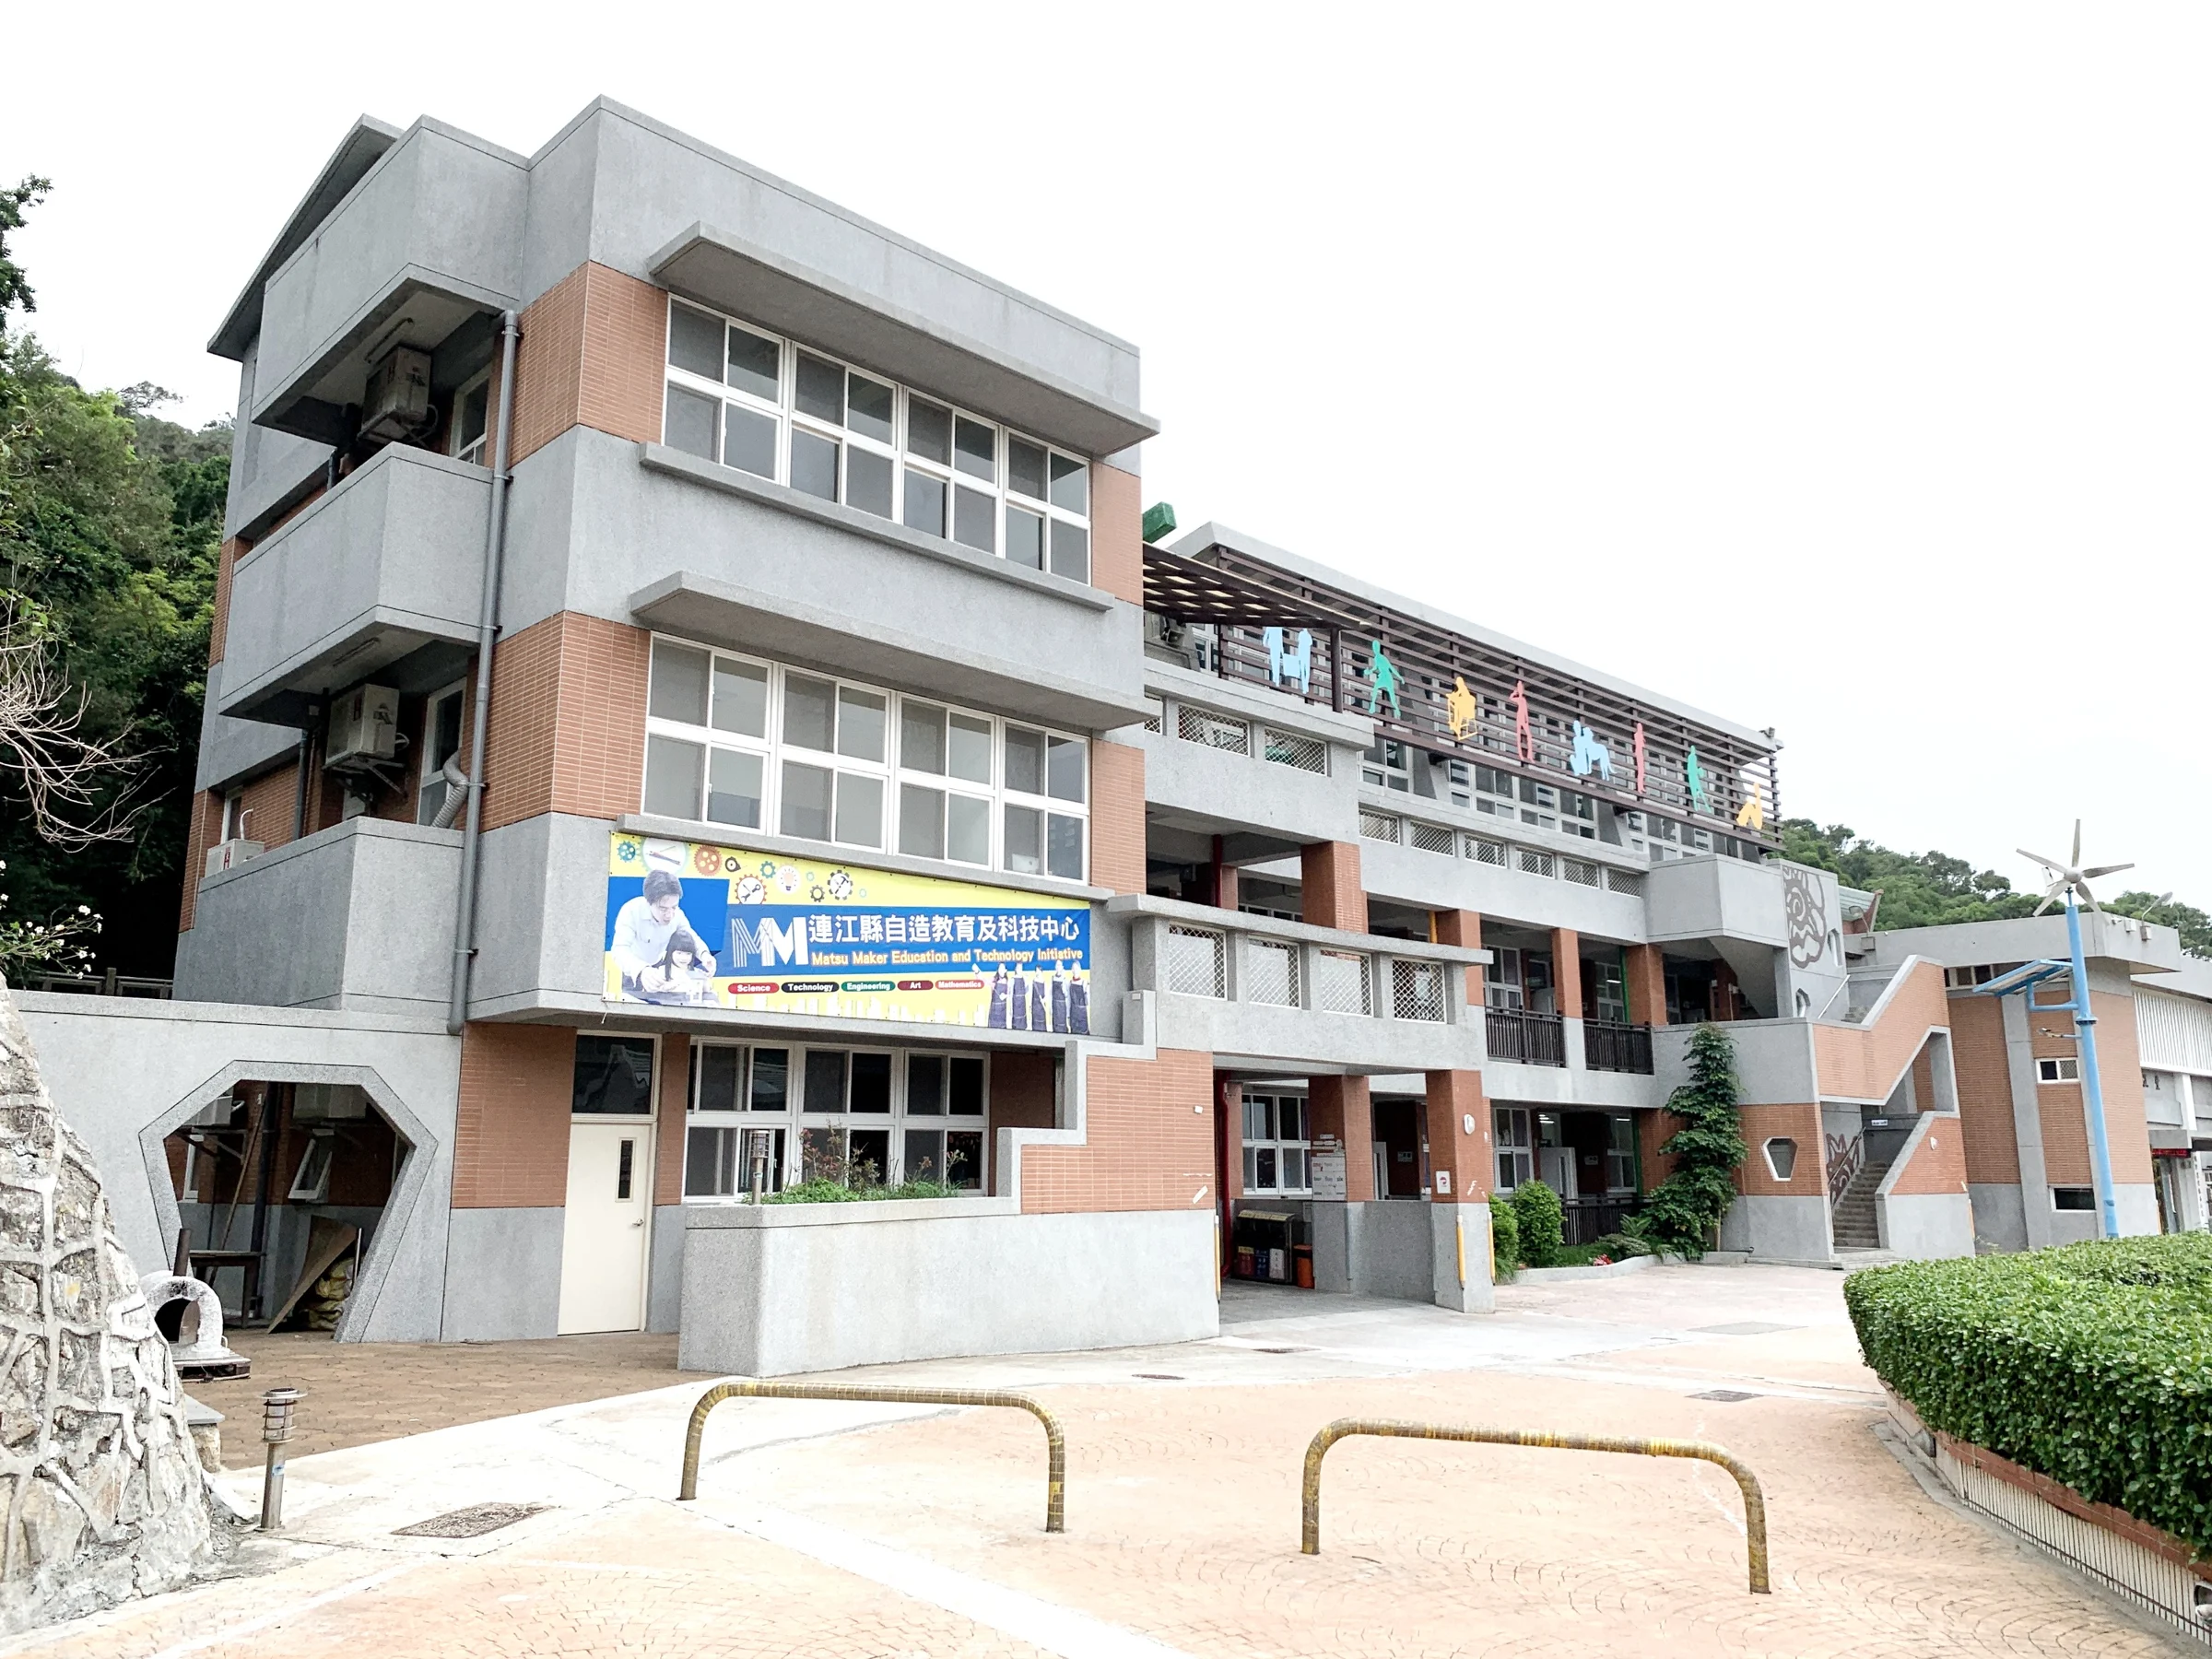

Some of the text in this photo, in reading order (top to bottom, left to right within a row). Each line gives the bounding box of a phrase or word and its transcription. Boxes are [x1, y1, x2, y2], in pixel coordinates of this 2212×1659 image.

[807, 913, 1080, 944] 連江縣自造教育及科技中心
[811, 947, 1084, 966] Matsu Maker Education and Technology Initiative
[736, 983, 771, 993] Science
[787, 982, 834, 993] Technology
[846, 982, 891, 992] Engineering
[910, 981, 923, 990] Art
[937, 981, 982, 989] Mathematics
